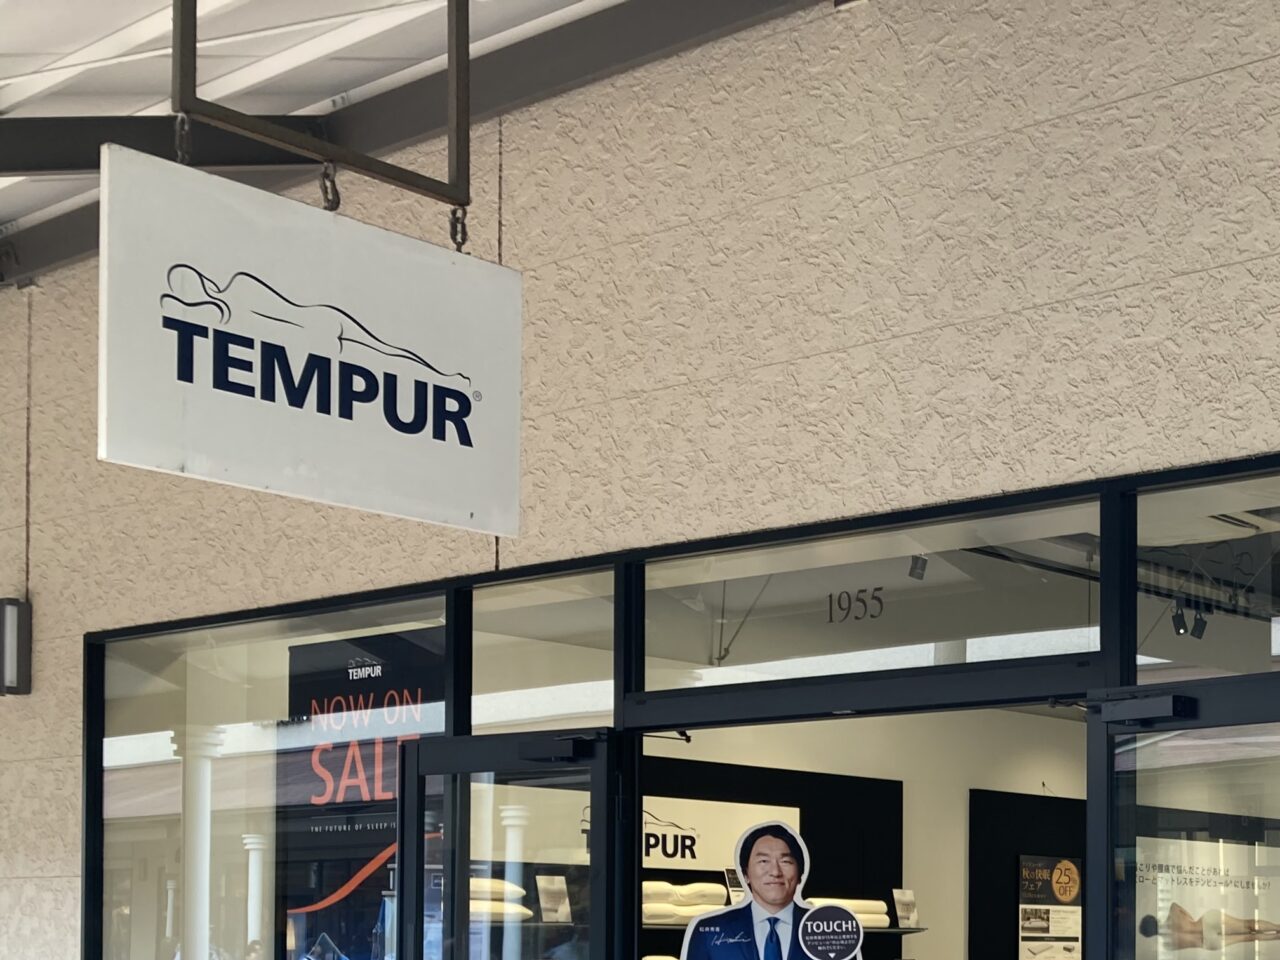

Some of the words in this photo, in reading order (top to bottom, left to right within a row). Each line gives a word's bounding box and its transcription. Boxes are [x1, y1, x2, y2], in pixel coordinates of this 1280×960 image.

[162, 316, 474, 448] TEMPUR
[826, 586, 884, 623] 1955
[348, 665, 382, 680] TEMPUR
[311, 693, 375, 731] NOW
[383, 688, 422, 725] ON
[1059, 885, 1073, 897] OFF
[805, 920, 857, 933] TOUCH!
